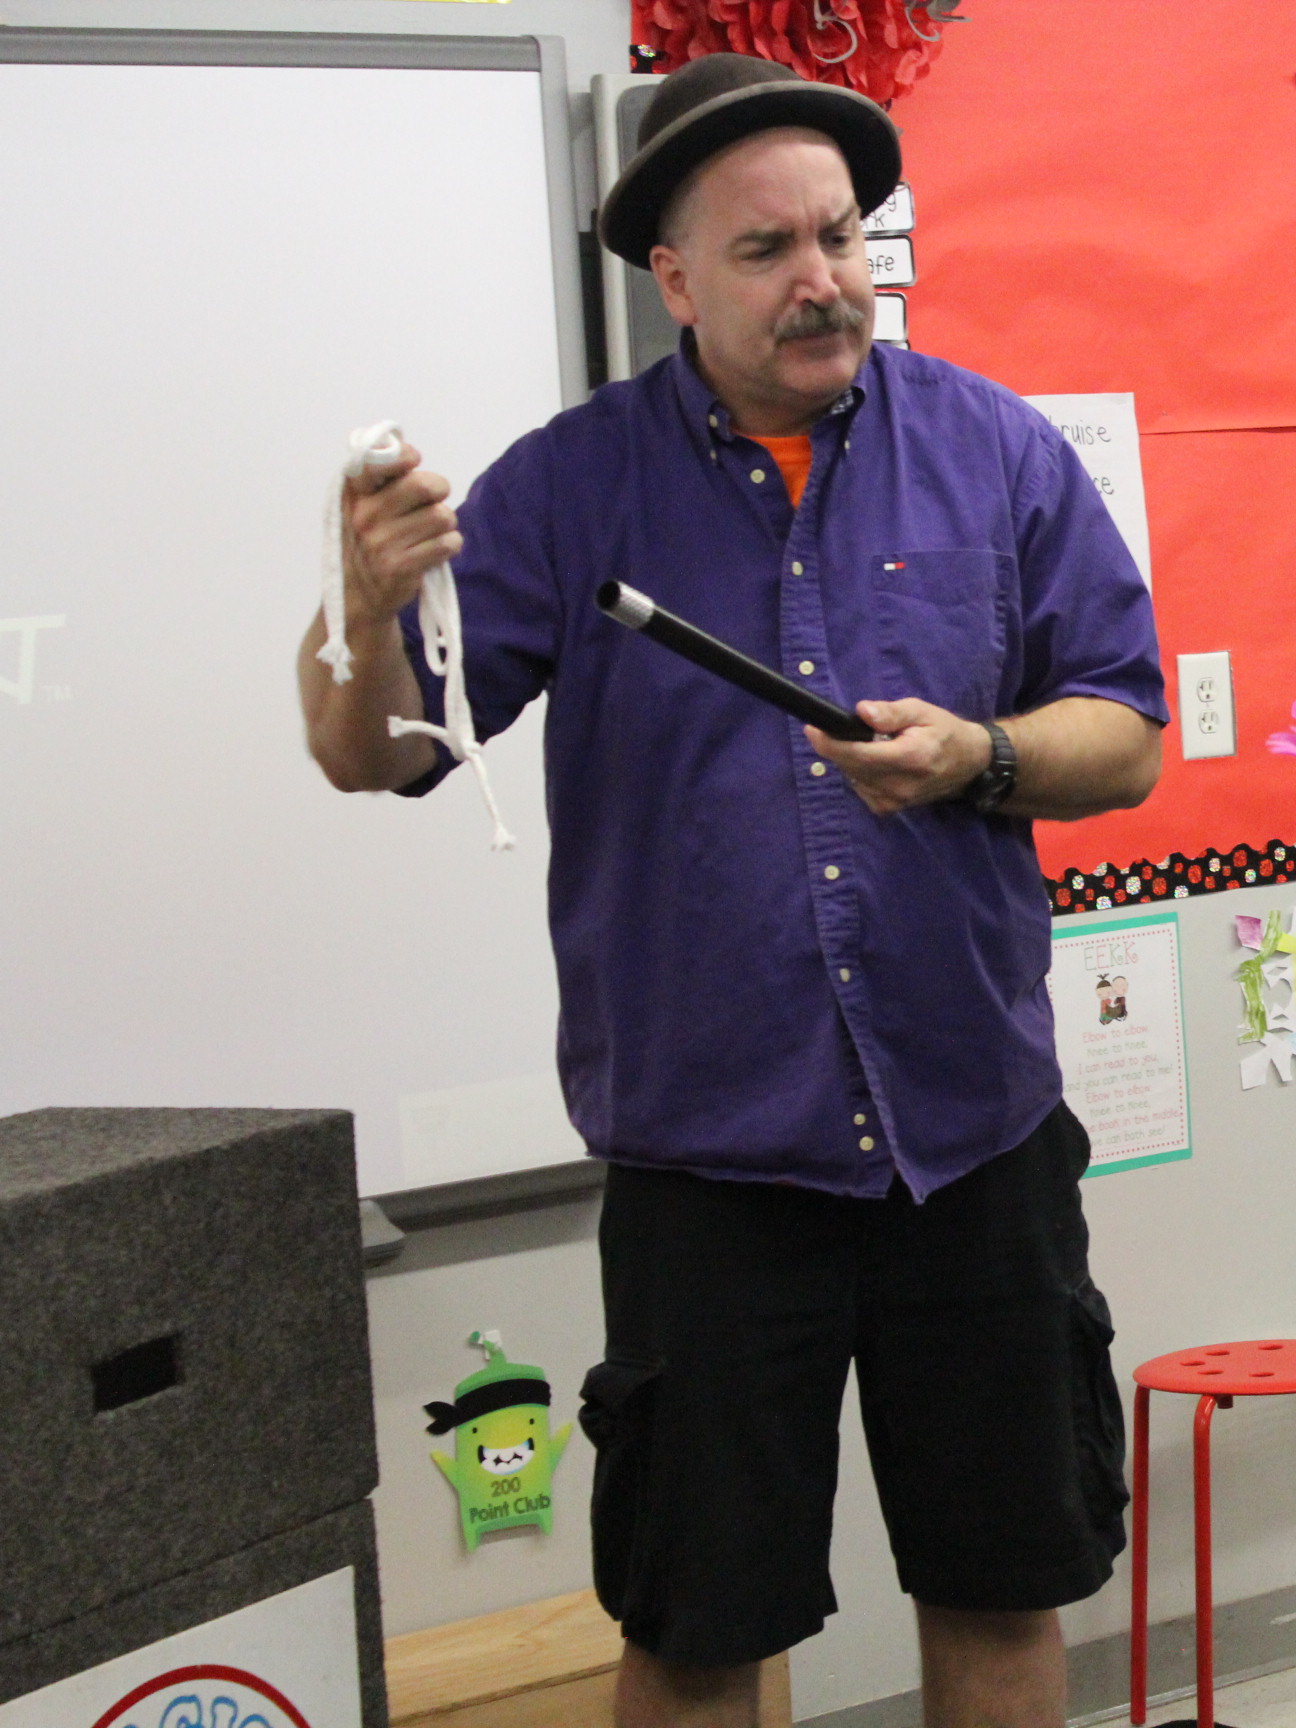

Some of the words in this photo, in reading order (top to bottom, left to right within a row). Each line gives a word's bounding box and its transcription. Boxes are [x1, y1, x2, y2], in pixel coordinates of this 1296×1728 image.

[1083, 941, 1139, 971] EEKK
[1082, 1031, 1107, 1043] Elbow
[1111, 1030, 1120, 1038] to
[1112, 1044, 1122, 1053] to
[1085, 1064, 1100, 1073] can
[1104, 1059, 1125, 1069] read
[1128, 1057, 1138, 1065] to
[1102, 1075, 1118, 1085] can
[1121, 1071, 1142, 1081] read
[1146, 1069, 1156, 1077] to
[1086, 1091, 1109, 1104] Elbow
[1114, 1089, 1124, 1098] to
[1115, 1104, 1125, 1113] to
[1135, 1115, 1149, 1125] the
[1106, 1134, 1121, 1144] can
[1124, 1130, 1144, 1141] both
[490, 1476, 521, 1498] 200
[469, 1501, 510, 1524] Point
[513, 1492, 551, 1514] Club
